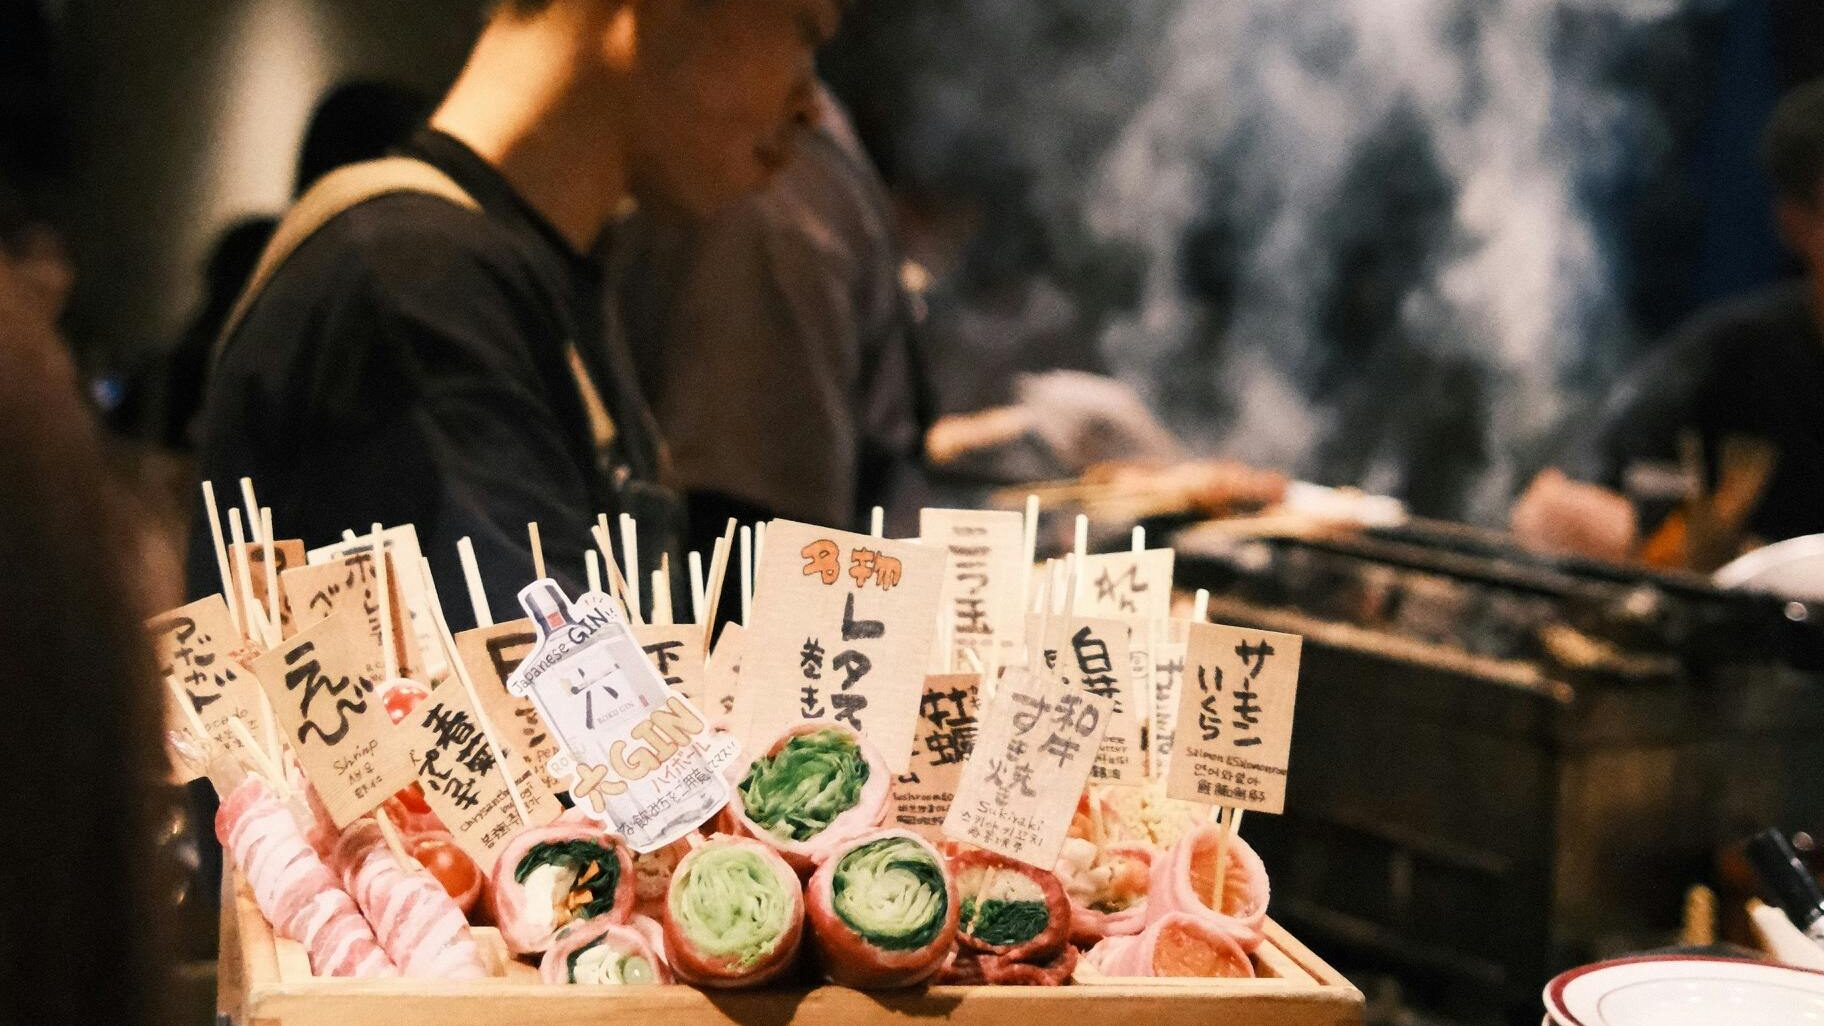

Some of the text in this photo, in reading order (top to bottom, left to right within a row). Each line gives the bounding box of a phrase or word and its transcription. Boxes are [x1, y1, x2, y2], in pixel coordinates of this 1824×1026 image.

[800, 539, 902, 591] 名物
[285, 641, 374, 746] えび
[511, 643, 570, 693] Japanese
[571, 663, 621, 730] 六
[800, 637, 825, 719] 巻き
[832, 592, 885, 731] レタス
[1234, 639, 1274, 747] サーモン
[1039, 694, 1099, 768] 和牛
[1198, 665, 1222, 740] いくら
[651, 741, 712, 794] ハイボール
